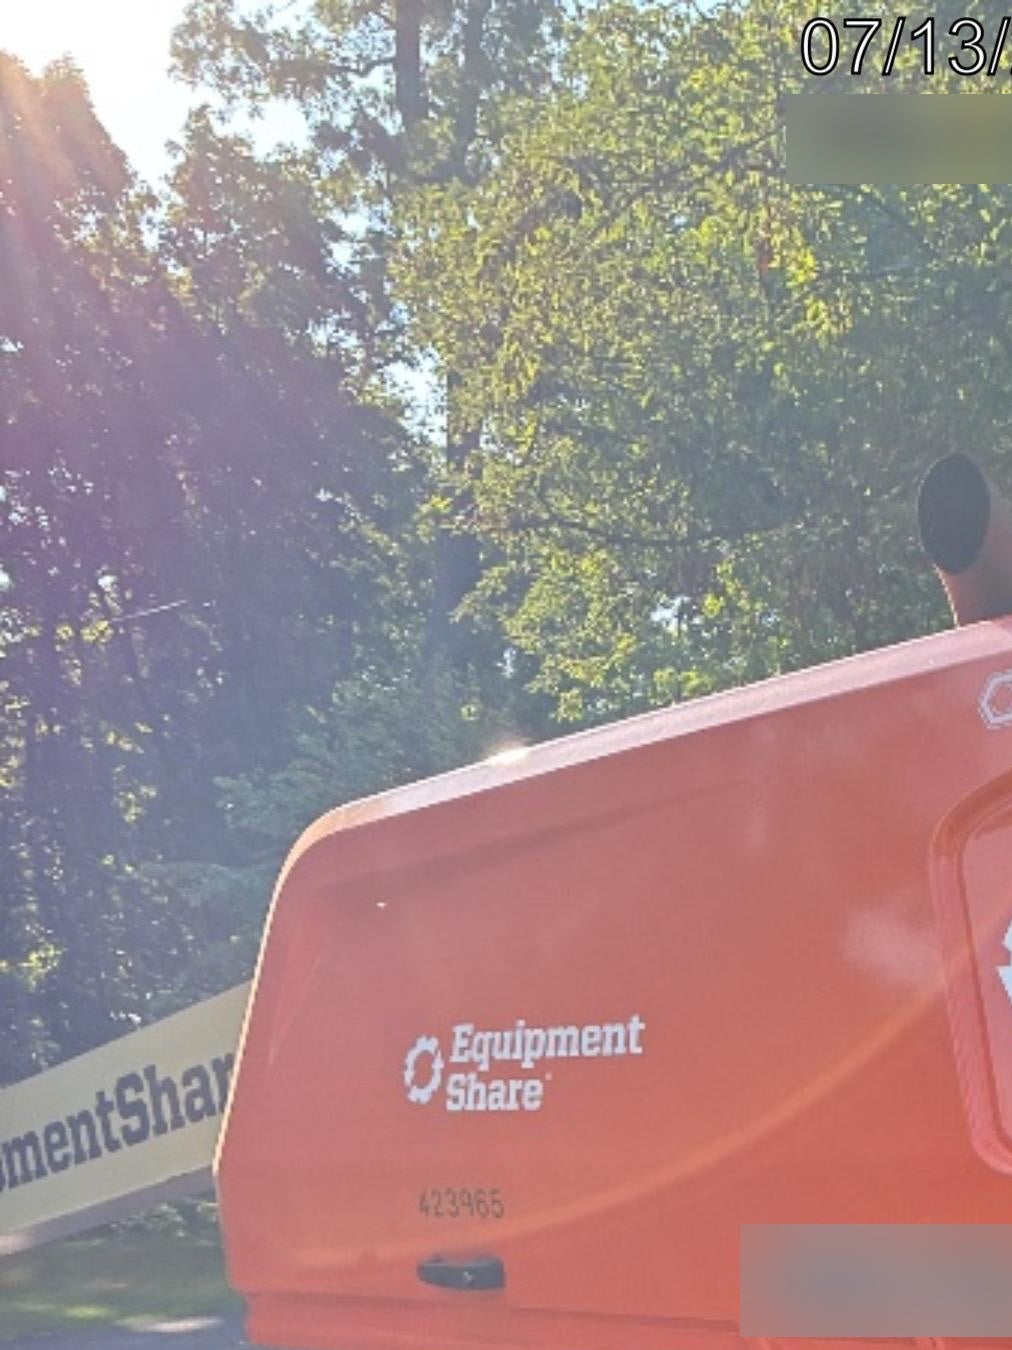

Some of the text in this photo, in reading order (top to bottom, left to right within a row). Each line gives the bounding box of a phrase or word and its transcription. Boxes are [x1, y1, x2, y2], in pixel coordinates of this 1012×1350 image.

[449, 1014, 646, 1071] Equipment
[446, 1072, 544, 1111] Share
[0, 1052, 236, 1193] mentShar
[418, 1187, 505, 1219] 423965
